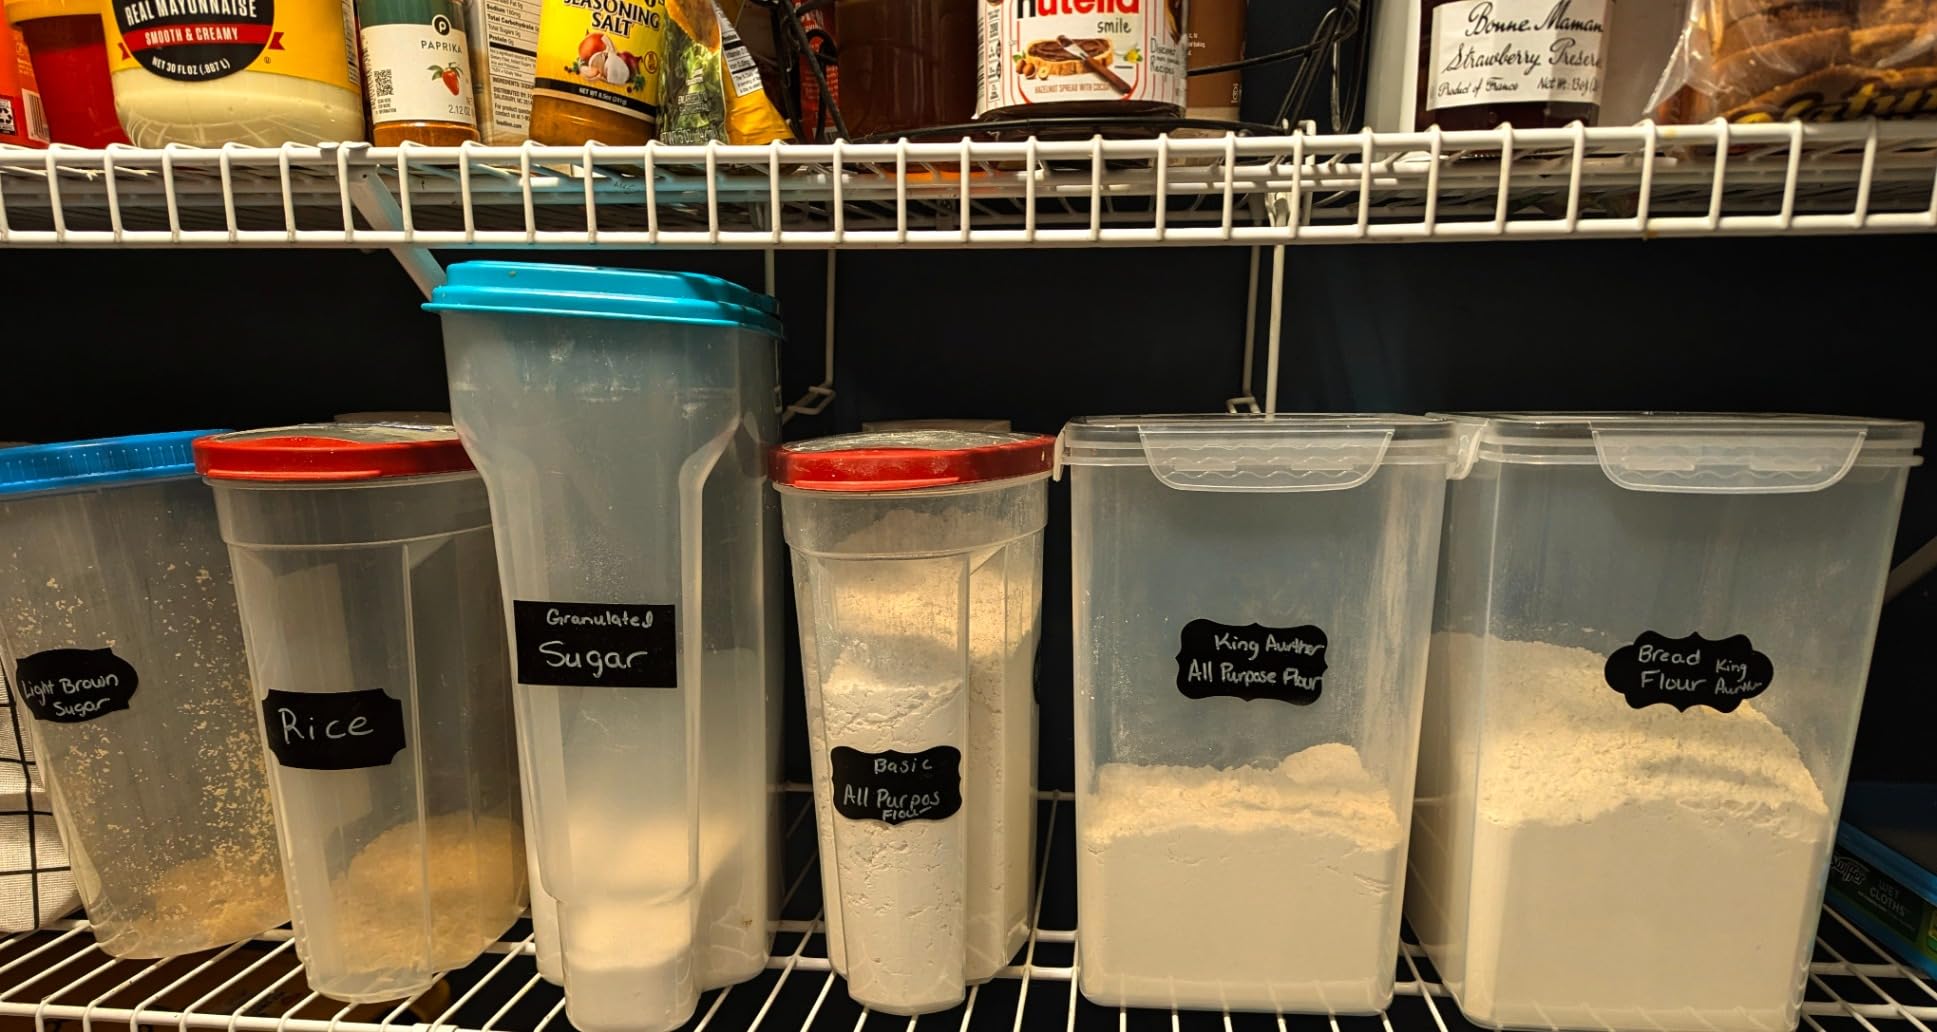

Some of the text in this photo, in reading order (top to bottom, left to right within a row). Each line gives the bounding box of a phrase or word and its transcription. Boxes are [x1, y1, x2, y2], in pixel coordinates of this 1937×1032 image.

[125, 0, 258, 26] REAL MAYONNAISE
[592, 12, 632, 36] SALT
[1097, 17, 1131, 33] smile
[1465, 0, 1604, 37] Bonne Maman
[145, 27, 238, 46] SMOOTH & CREAMY
[421, 40, 462, 54] PAPRIKA
[152, 57, 165, 70] NET
[167, 62, 176, 73] 30
[187, 64, 198, 75] OZ
[1441, 42, 1541, 75] Strawberry
[1438, 77, 1518, 97] Product of France
[546, 608, 654, 629] Granulated
[1214, 632, 1260, 661] King
[1638, 644, 1701, 665] Bread
[538, 640, 649, 678] Sugar
[1715, 658, 1747, 683] King
[1188, 658, 1325, 691] All Purpose Flour
[1640, 669, 1706, 691] Flour
[21, 674, 119, 707] Light Brown
[53, 698, 111, 717] Sugar
[278, 707, 374, 744] Rice
[874, 757, 933, 775] Basic
[843, 783, 869, 808] All
[1869, 887, 1905, 917] CLOTHS
